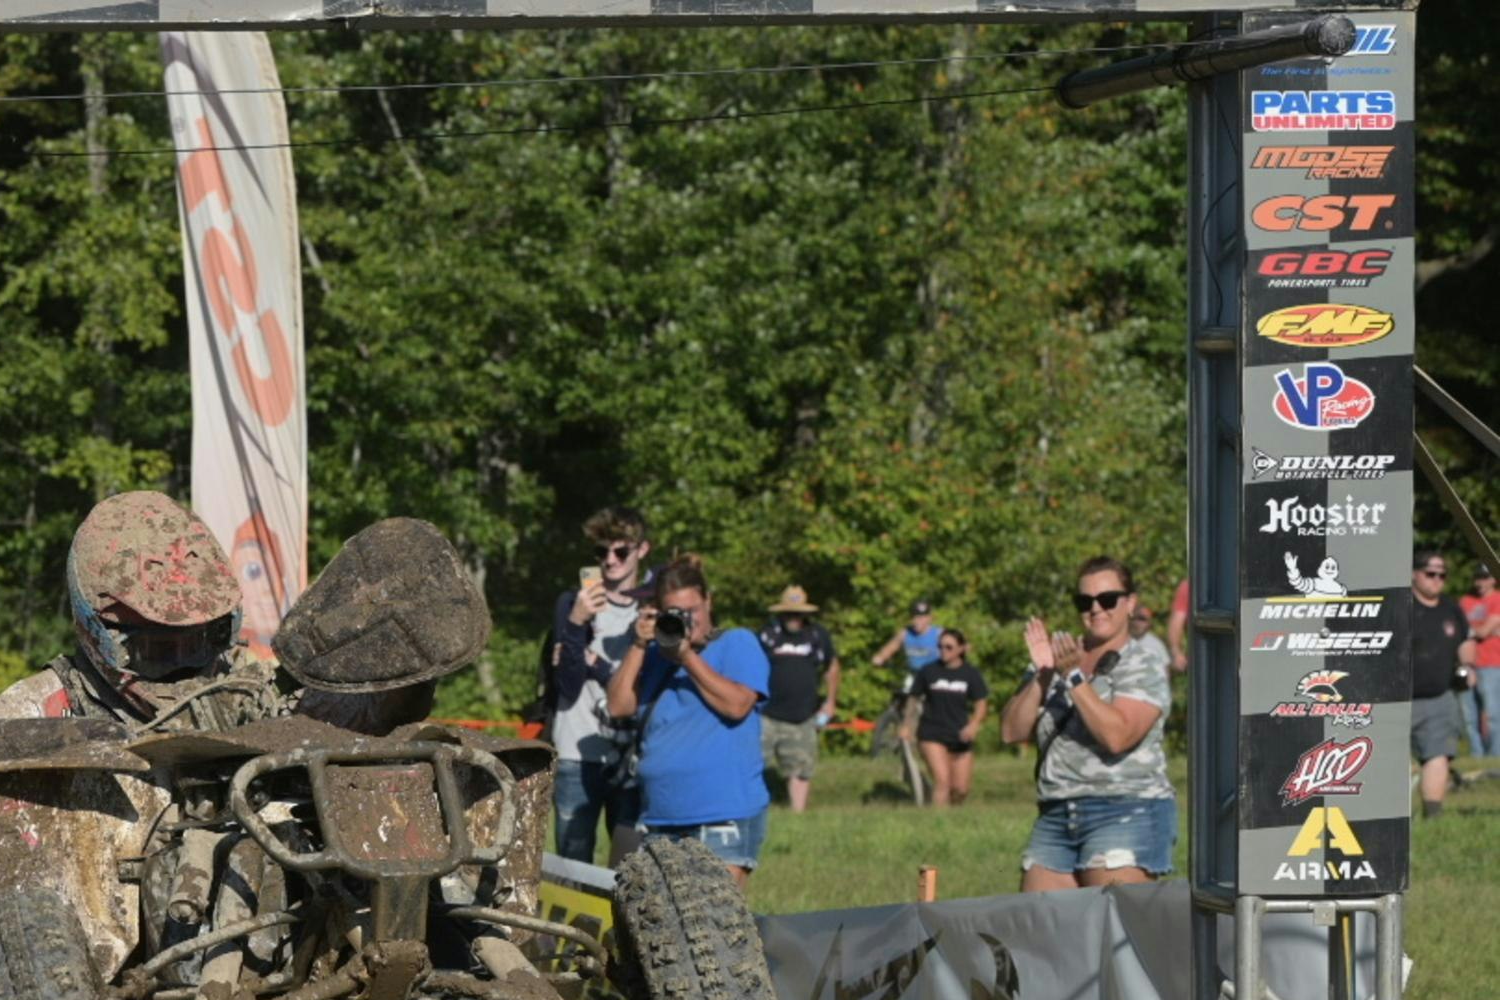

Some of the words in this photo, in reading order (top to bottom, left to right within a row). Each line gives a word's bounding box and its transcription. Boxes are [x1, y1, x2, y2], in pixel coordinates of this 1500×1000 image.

[1253, 92, 1394, 114] PARTS
[1253, 114, 1394, 129] UNLIMITED
[1251, 145, 1396, 168] MOOSE
[1307, 167, 1382, 179] RACING
[1252, 194, 1396, 231] CST
[1257, 250, 1393, 276] GBC
[1268, 278, 1336, 288] POWERSPORTS
[1258, 309, 1392, 336] FMF
[1275, 363, 1345, 428] VP
[1279, 454, 1396, 470] DUNLOP
[1275, 470, 1348, 479] MOTORCYCLE
[1352, 469, 1386, 479] TIRES
[1258, 494, 1387, 534] Hoosier
[1297, 526, 1347, 536] RACING
[1352, 525, 1378, 535] TIRE
[1259, 603, 1382, 619] MICHELIN
[1269, 703, 1307, 716] ALL
[1309, 703, 1372, 716] BALLS
[1273, 860, 1377, 880] ARMA
